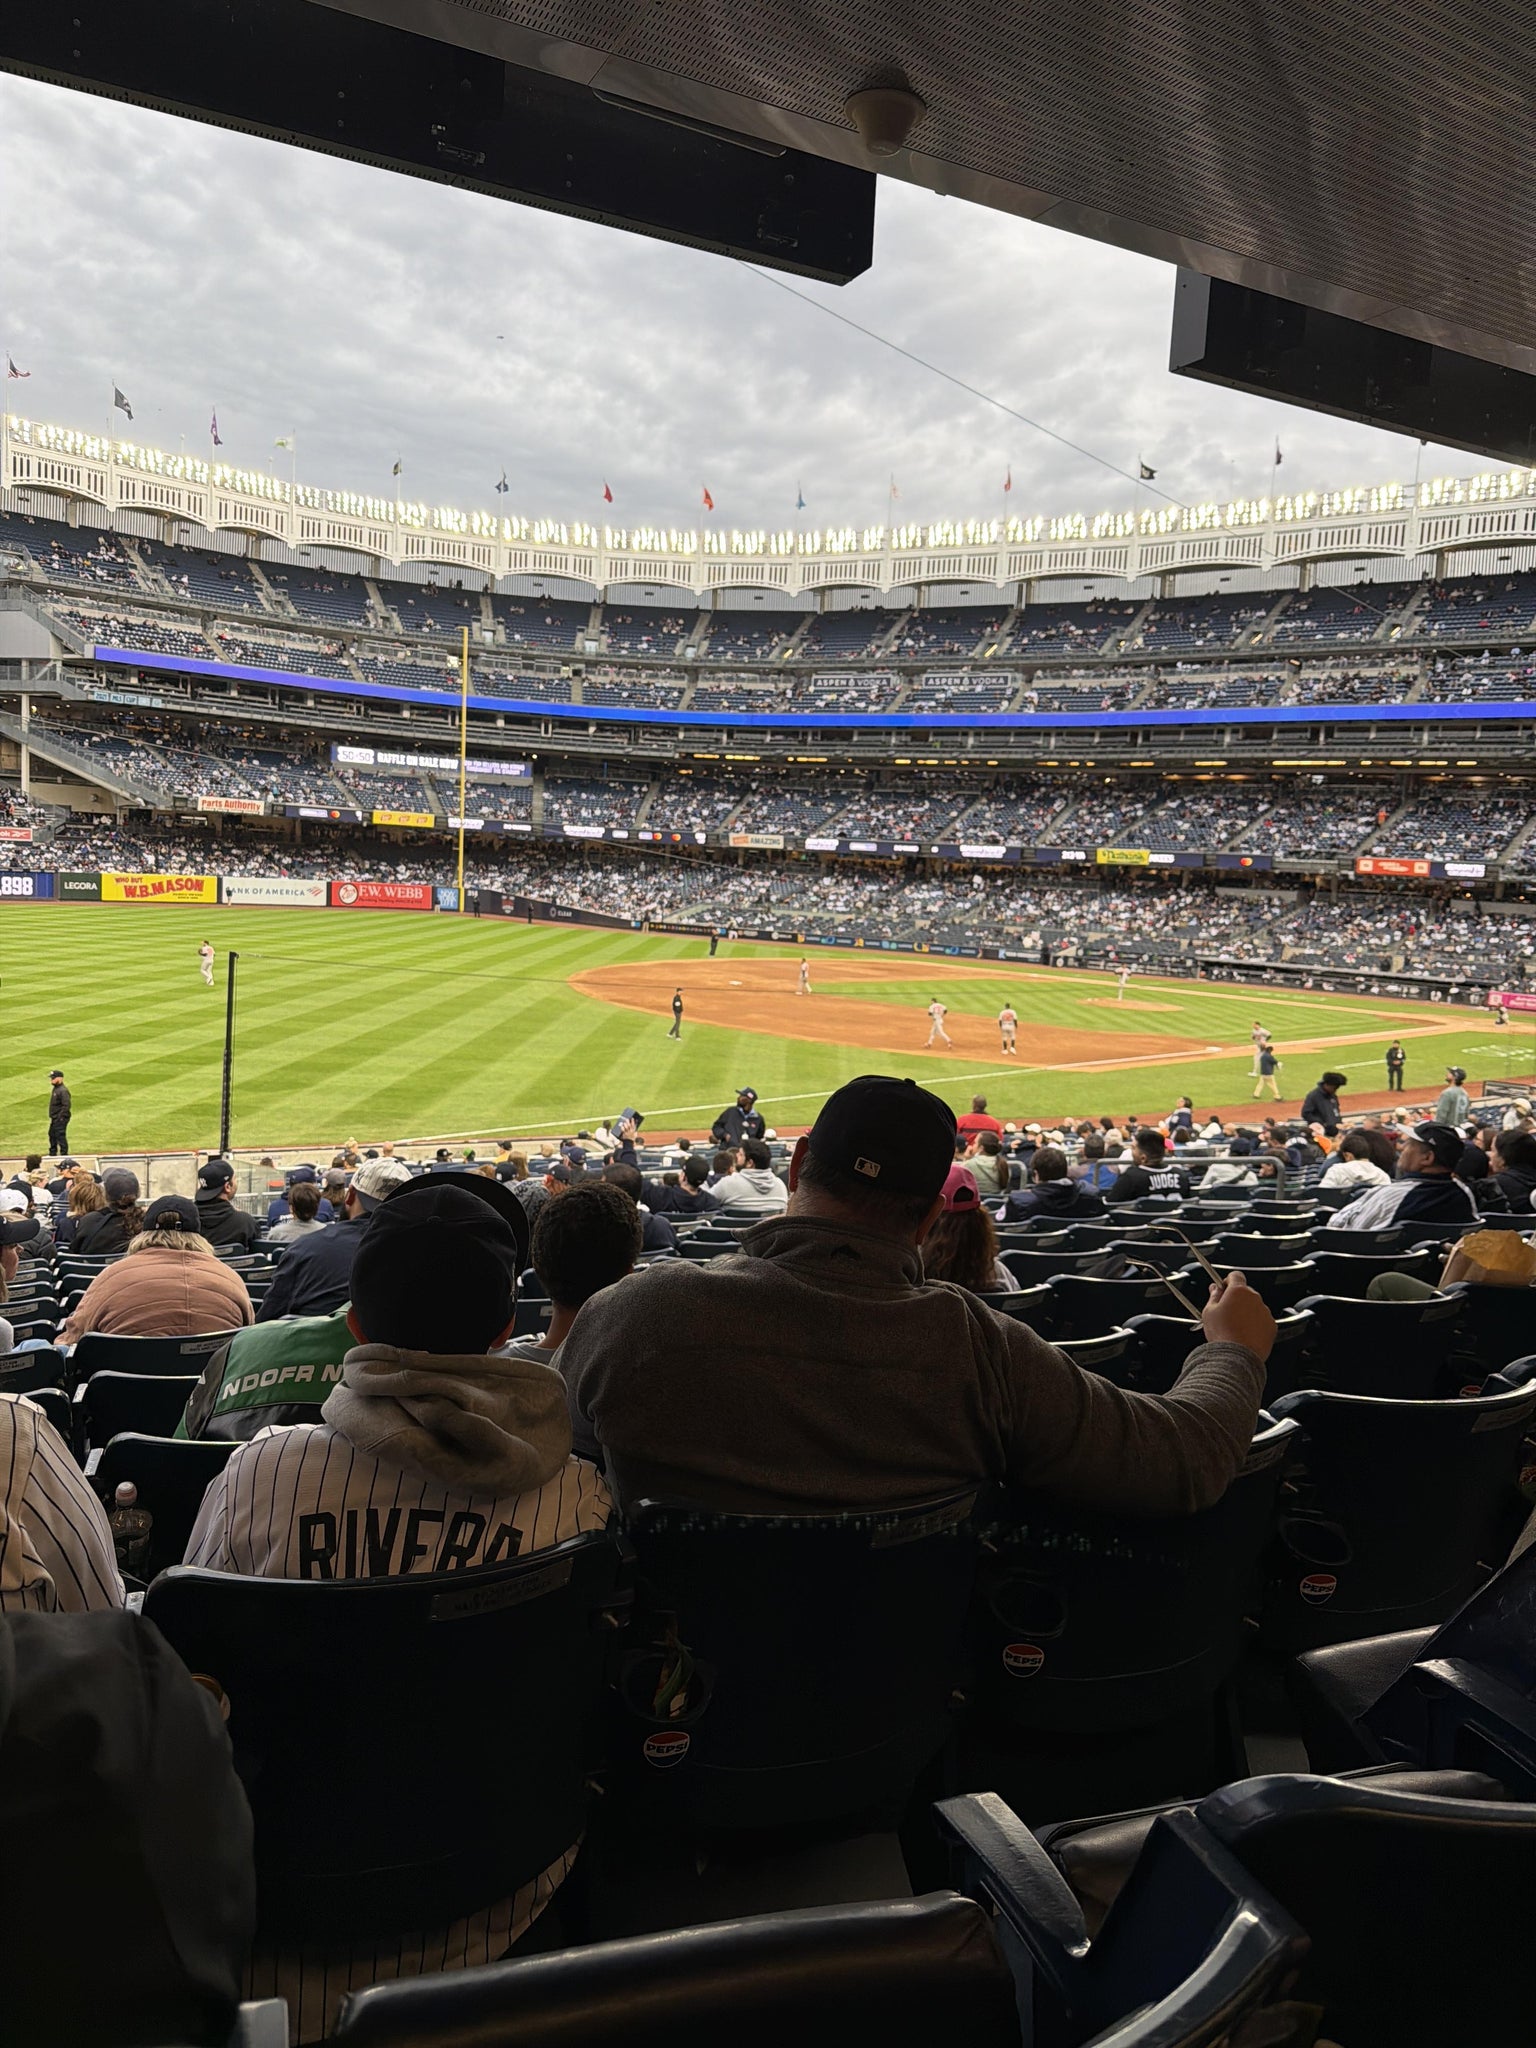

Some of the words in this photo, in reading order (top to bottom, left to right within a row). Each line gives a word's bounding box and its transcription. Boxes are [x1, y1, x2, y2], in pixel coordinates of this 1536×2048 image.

[816, 679, 847, 687] ASPEN
[927, 678, 961, 686] ASPEN
[971, 677, 1005, 685] VODKA
[376, 751, 406, 765] RAFFLE
[406, 754, 418, 766] ON
[418, 756, 438, 769] SALE
[439, 758, 459, 770] NOW
[201, 799, 222, 808] Parts
[224, 799, 261, 812] Authority
[64, 882, 98, 891] LEGORA
[265, 888, 306, 896] AMERICA
[384, 886, 423, 899] WEBB
[1148, 1173, 1182, 1191] JUDGE
[1005, 1650, 1043, 1665] PEPSI
[646, 1740, 688, 1754] PEPSI
